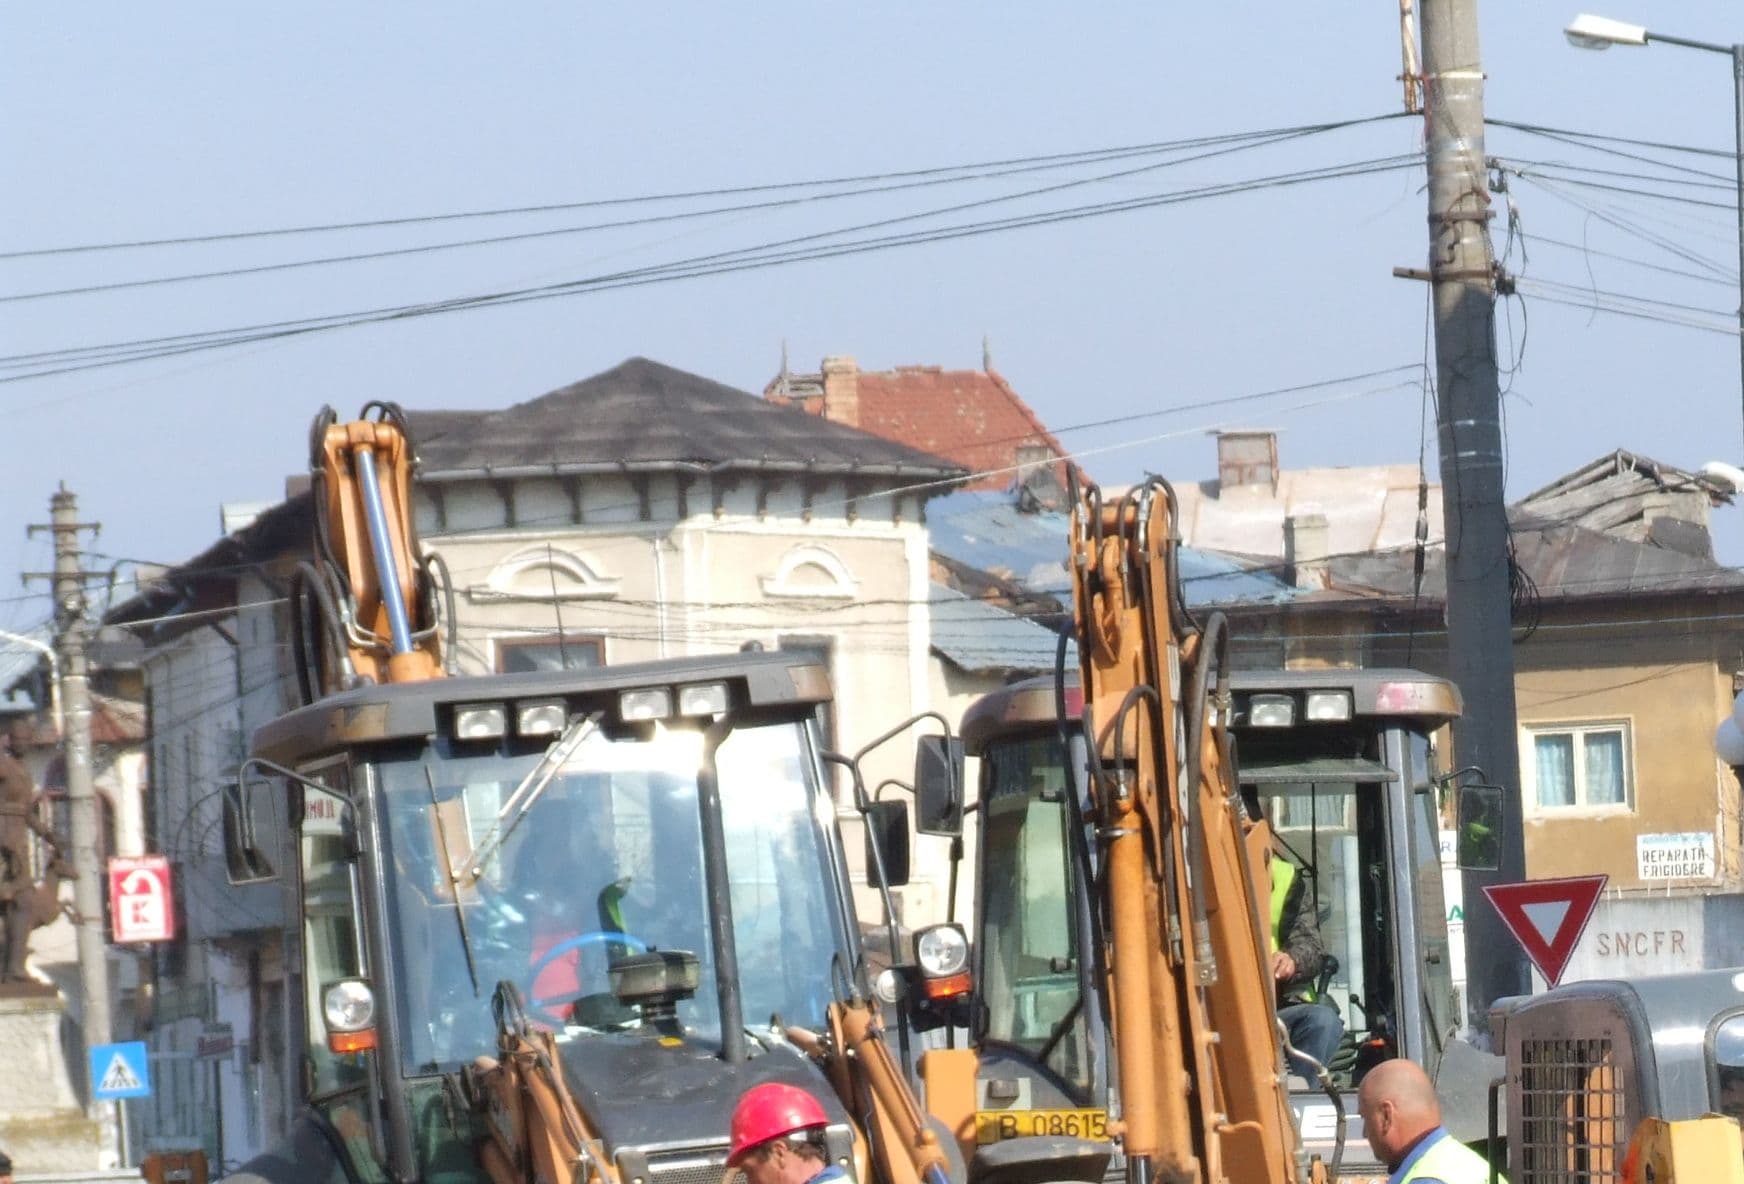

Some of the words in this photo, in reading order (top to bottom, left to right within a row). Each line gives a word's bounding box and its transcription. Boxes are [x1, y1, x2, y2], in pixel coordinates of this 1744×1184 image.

[1597, 929, 1686, 957] SNCFR
[1000, 1114, 1017, 1138] B
[1032, 1113, 1106, 1138] 08615
